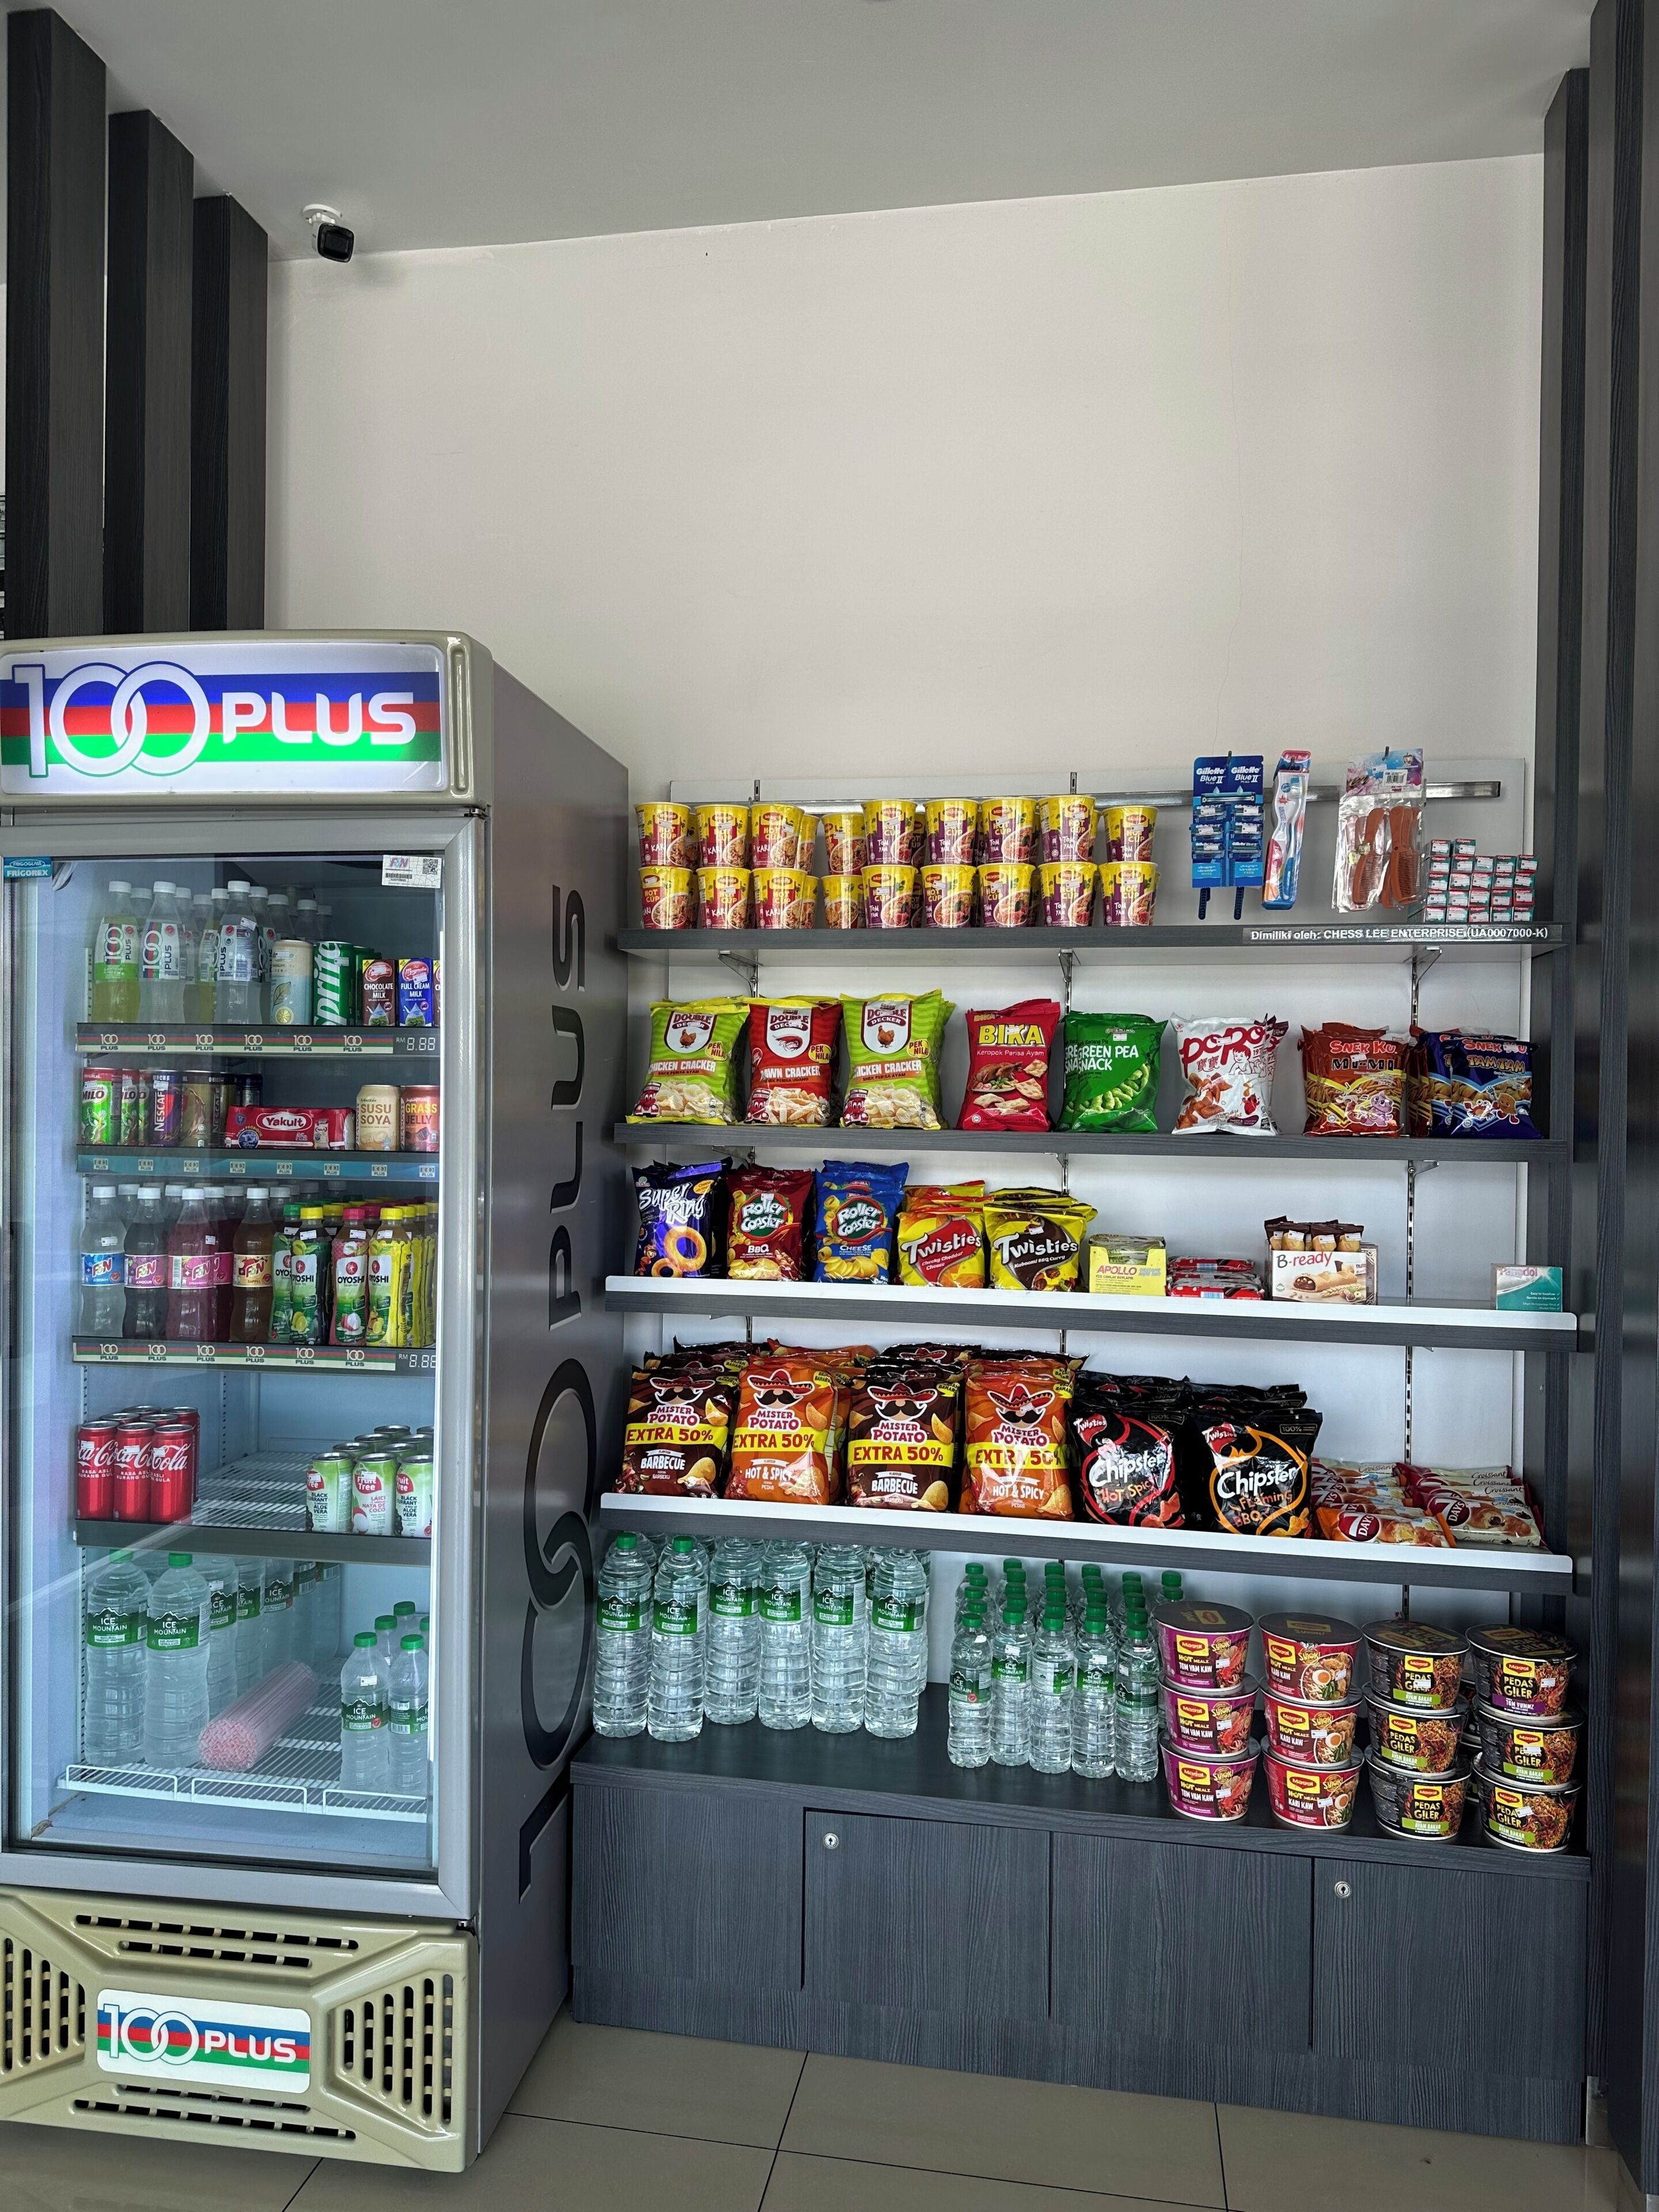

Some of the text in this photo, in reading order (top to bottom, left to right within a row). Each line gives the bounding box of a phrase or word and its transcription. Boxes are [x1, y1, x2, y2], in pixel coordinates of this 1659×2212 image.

[12, 661, 416, 778] 100 PLUS
[1251, 930, 1291, 940] Dimiliki
[1294, 930, 1321, 940] oleh:
[1324, 929, 1363, 939] CHESS
[1366, 929, 1389, 938] LEE
[1391, 928, 1464, 938] ENTERPRISE
[104, 926, 123, 961] 100
[142, 930, 162, 972] 100
[673, 1014, 712, 1025] DOUBLE
[871, 1017, 902, 1025] DECKER
[100, 1034, 118, 1044] 100
[147, 1034, 165, 1045] 100
[244, 1035, 263, 1046] 100
[343, 1035, 362, 1046] 100
[978, 1023, 1045, 1047] BIKA
[407, 1037, 435, 1051] 8.88
[910, 1040, 922, 1049] PEK
[977, 1050, 1003, 1058] Keropok
[1025, 1050, 1044, 1058] Ayam
[1078, 1045, 1139, 1060] GREEN PEA
[680, 1059, 716, 1073] CRACKER
[885, 1059, 922, 1073] CRACKER
[1078, 1058, 1112, 1074] SNACK
[1467, 1054, 1525, 1074] TAM TAM
[785, 1066, 820, 1078] CRACKER
[154, 1088, 165, 1132] NESCAF
[361, 1104, 392, 1113] SUSU
[406, 1103, 438, 1113] GRASS
[548, 885, 585, 1331] PLUS
[263, 1116, 304, 1127] Yakult
[361, 1115, 391, 1125] SOYA
[406, 1115, 431, 1124] JELLY
[837, 1203, 882, 1225] Roller
[748, 1244, 769, 1253] BBQ
[901, 1233, 982, 1264] Twisties
[994, 1233, 1079, 1264] Twisties
[941, 1251, 964, 1261] Cheddar
[1276, 1251, 1332, 1268] B-ready
[926, 1262, 945, 1271] Cheese
[1096, 1265, 1137, 1275] APOLLO
[338, 1275, 365, 1284] OYOSHI
[657, 1406, 692, 1415] MISTER
[757, 1411, 793, 1419] MISTER
[649, 1414, 698, 1426] POTATO
[750, 1418, 800, 1430] POTATO
[1073, 1418, 1107, 1434] Twisties
[880, 1422, 918, 1431] MISTER
[627, 1427, 713, 1442] EXTRA 50%
[873, 1430, 926, 1443] POTATO
[733, 1434, 815, 1448] EXTRA 50%
[854, 1447, 944, 1462] EXTRA 50%
[641, 1456, 686, 1471] BARBECUE
[1089, 1450, 1164, 1487] Chipster
[745, 1467, 769, 1479] HOT &
[872, 1479, 918, 1494] BARBECUE
[1217, 1463, 1297, 1498] Chipster
[993, 1485, 1044, 1499] HOT & SPICY
[1485, 1486, 1524, 1494] Croissant
[1448, 1501, 1465, 1522] DAYS
[1358, 1514, 1374, 1537] DAYS
[715, 1595, 744, 1603] MOUNTAIN
[723, 1589, 736, 1597] ICE
[608, 1604, 622, 1612] ICE
[1179, 1654, 1193, 1662] HOT
[1179, 1662, 1213, 1673] TOM YAM KAW
[1503, 1676, 1533, 1688] PEDAS
[1280, 1733, 1304, 1746] KARI KAW
[1414, 1802, 1440, 1810] PEDAS
[103, 2003, 297, 2066] 100 PLUS
